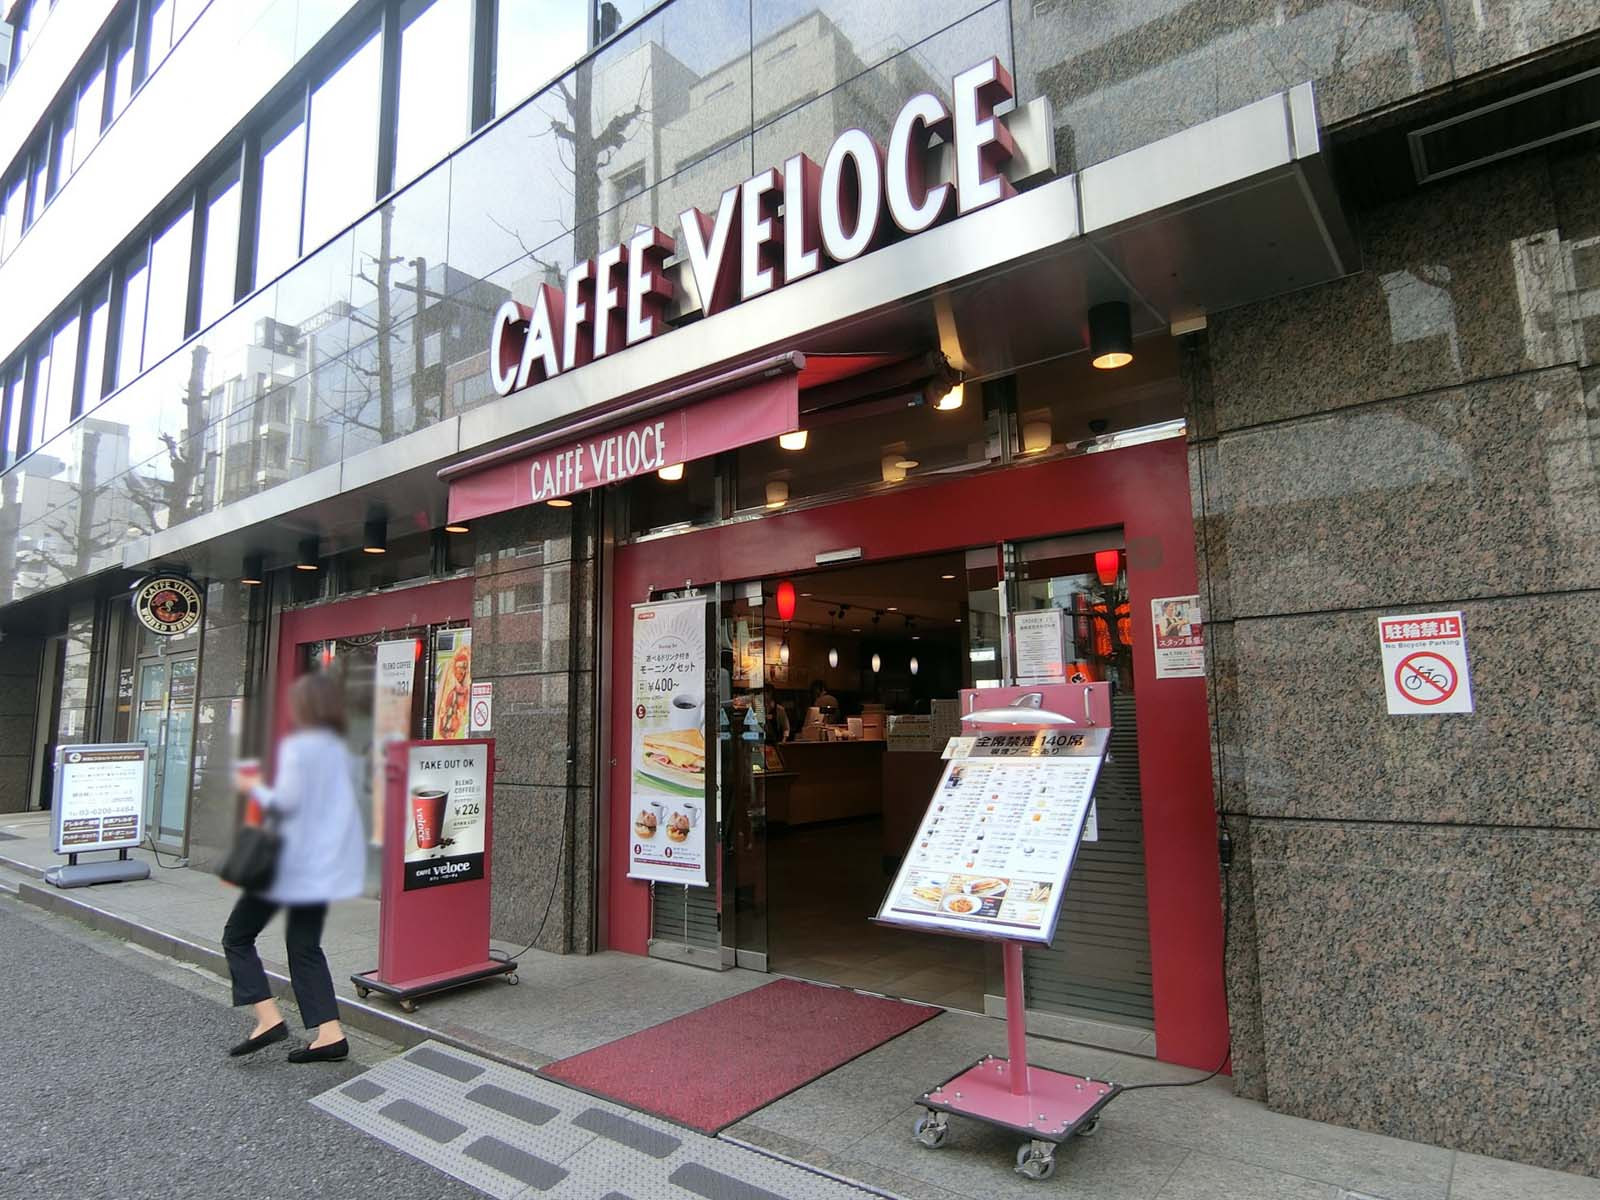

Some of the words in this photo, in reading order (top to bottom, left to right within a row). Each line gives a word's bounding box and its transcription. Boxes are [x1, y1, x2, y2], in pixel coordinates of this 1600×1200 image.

[678, 55, 1005, 318] VELOCE
[530, 444, 584, 500] CAFFÈ
[590, 421, 666, 483] VELOCE
[141, 608, 168, 631] WORLD
[170, 611, 196, 631] BEANS
[1384, 620, 1458, 639] 駐輪禁止
[1398, 641, 1426, 649] Bicycle
[1429, 639, 1460, 647] Parking
[640, 661, 696, 674] モーニングセット
[976, 735, 1036, 748] 全席禁煙
[1041, 734, 1084, 747] 140席
[420, 760, 442, 770] TAKE
[444, 760, 460, 769] OUT
[463, 758, 474, 768] OK
[433, 861, 471, 875] veloce
